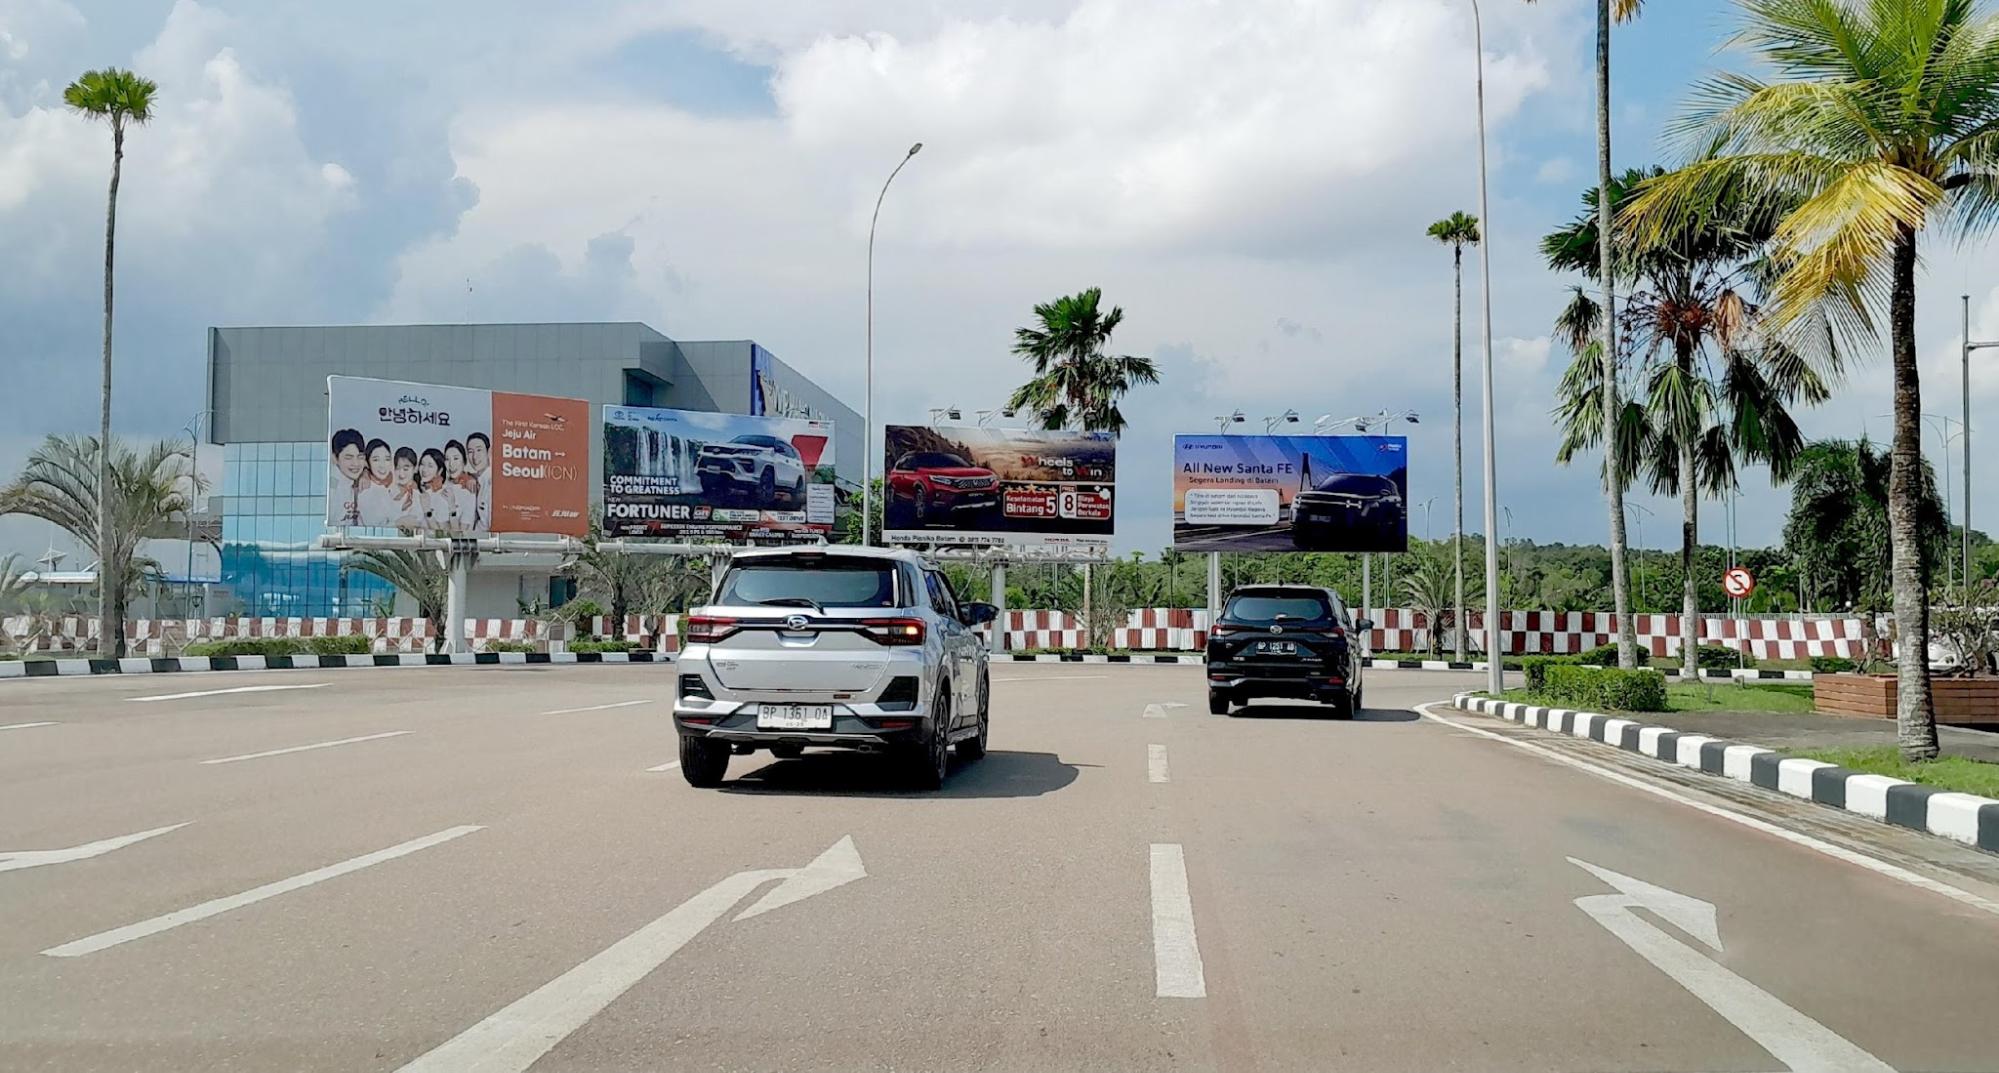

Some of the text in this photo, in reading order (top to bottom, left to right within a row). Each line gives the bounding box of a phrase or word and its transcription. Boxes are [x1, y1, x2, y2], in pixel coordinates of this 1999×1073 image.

[379, 407, 451, 426] 안녕하세요
[502, 429, 537, 440] Jeju Air
[502, 443, 552, 461] Batam
[1021, 456, 1074, 468] Wheels
[1063, 467, 1103, 476] to Win
[1183, 463, 1293, 474] All New Santa FE
[610, 475, 678, 486] COMMITMENT
[1216, 476, 1245, 485] Landing
[610, 484, 680, 495] TO GREATNESS
[1006, 496, 1056, 516] Bintang 5
[1065, 495, 1073, 511] 8
[607, 503, 690, 519] FORTUNER
[763, 706, 777, 720] BP
[783, 707, 807, 720] 1361
